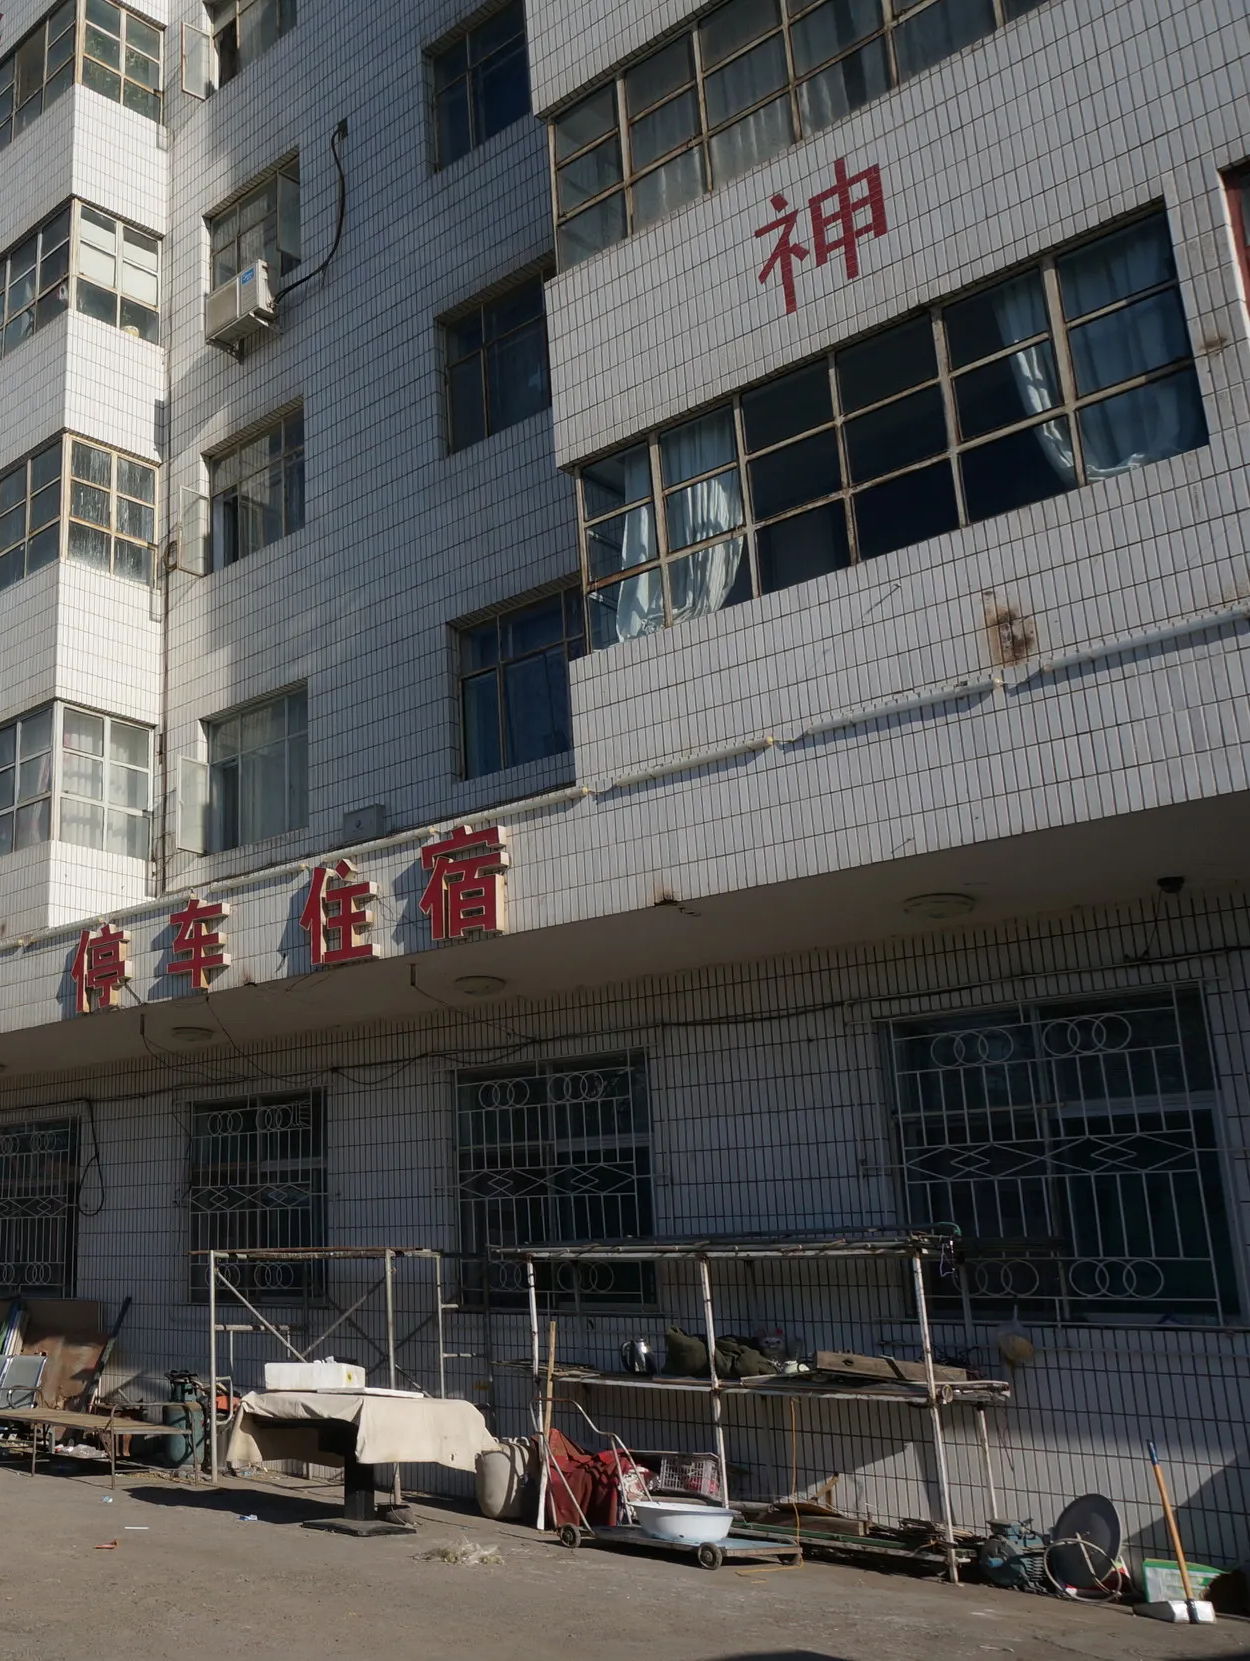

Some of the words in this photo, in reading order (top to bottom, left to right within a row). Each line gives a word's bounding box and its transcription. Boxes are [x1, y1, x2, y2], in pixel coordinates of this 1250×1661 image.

[754, 157, 888, 314] 神
[70, 825, 510, 1013] 停车住宿
